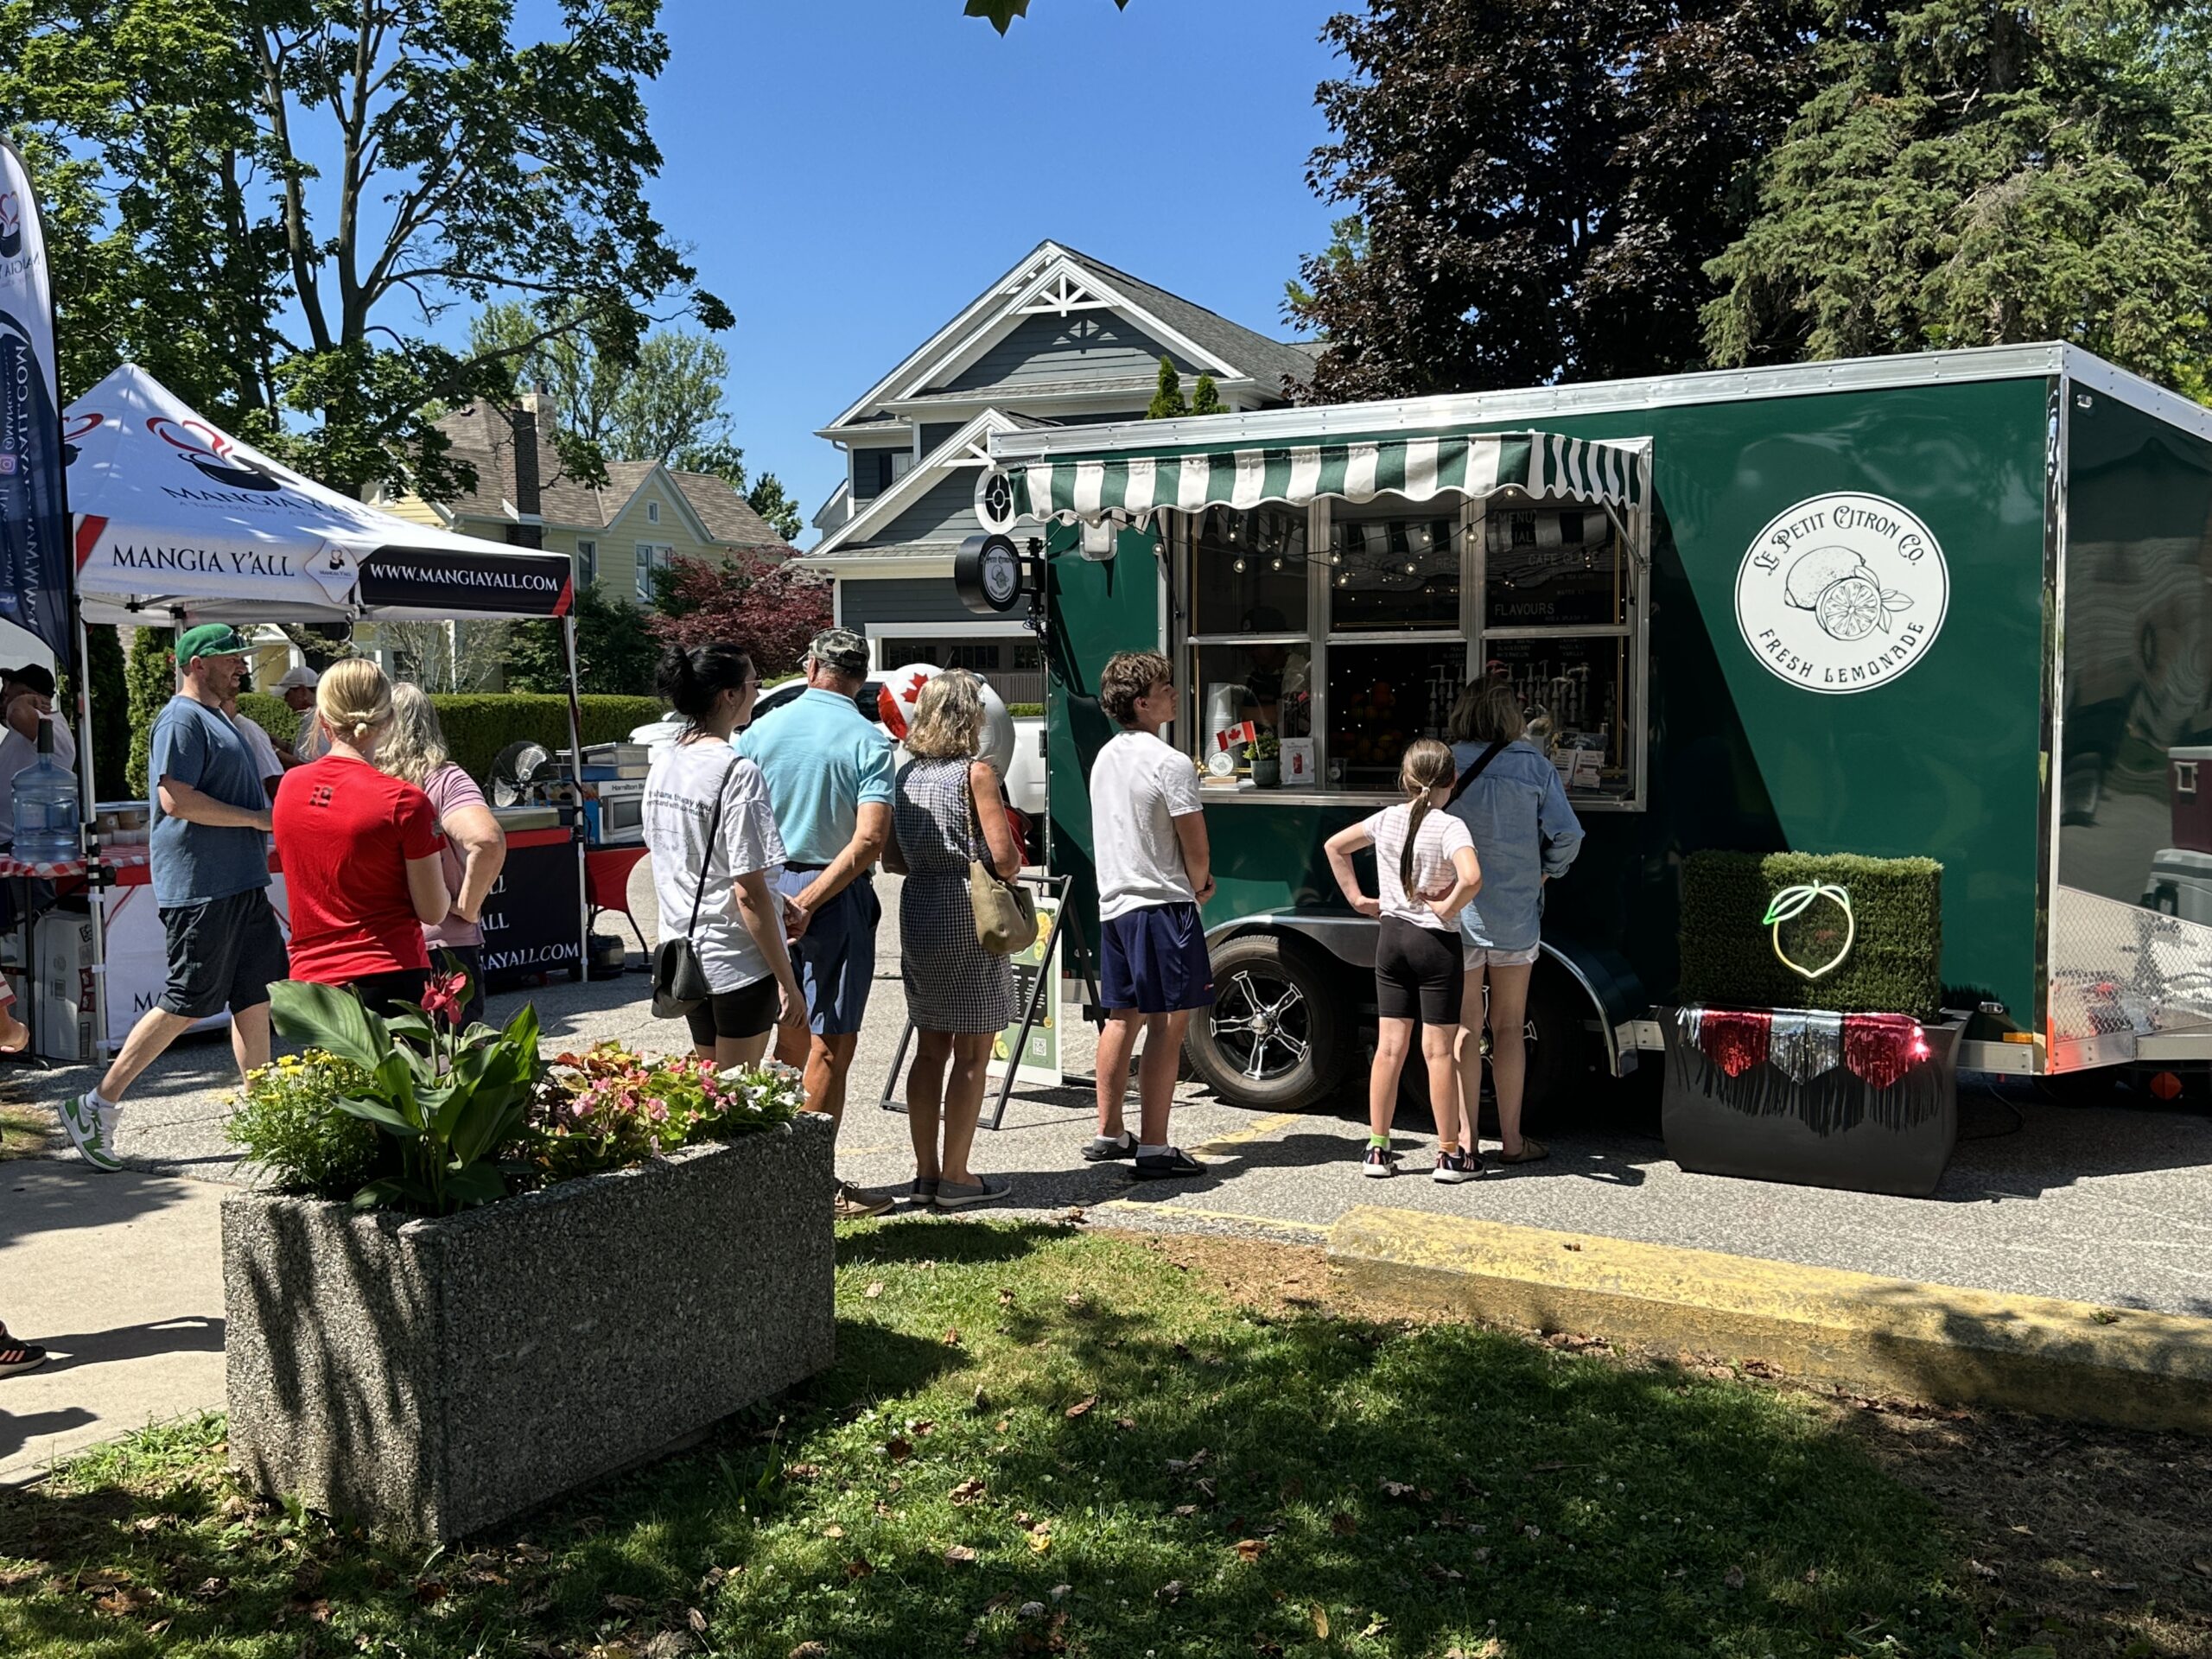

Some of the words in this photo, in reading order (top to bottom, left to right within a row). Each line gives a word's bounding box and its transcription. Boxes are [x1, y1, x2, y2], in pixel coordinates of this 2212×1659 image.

[160, 486, 304, 510] MANGIA
[1753, 550, 1780, 576] LE
[1771, 512, 1825, 554] PETIT
[1833, 505, 1901, 539] CITRON
[113, 543, 226, 574] MANGIA
[232, 549, 295, 577] Y'ALL
[370, 562, 559, 593] WWW.MANGIAYALL.COM
[1495, 602, 1555, 616] FLAVOURS
[1759, 628, 1814, 678] FRESH
[1824, 621, 1925, 683] LEMONADE
